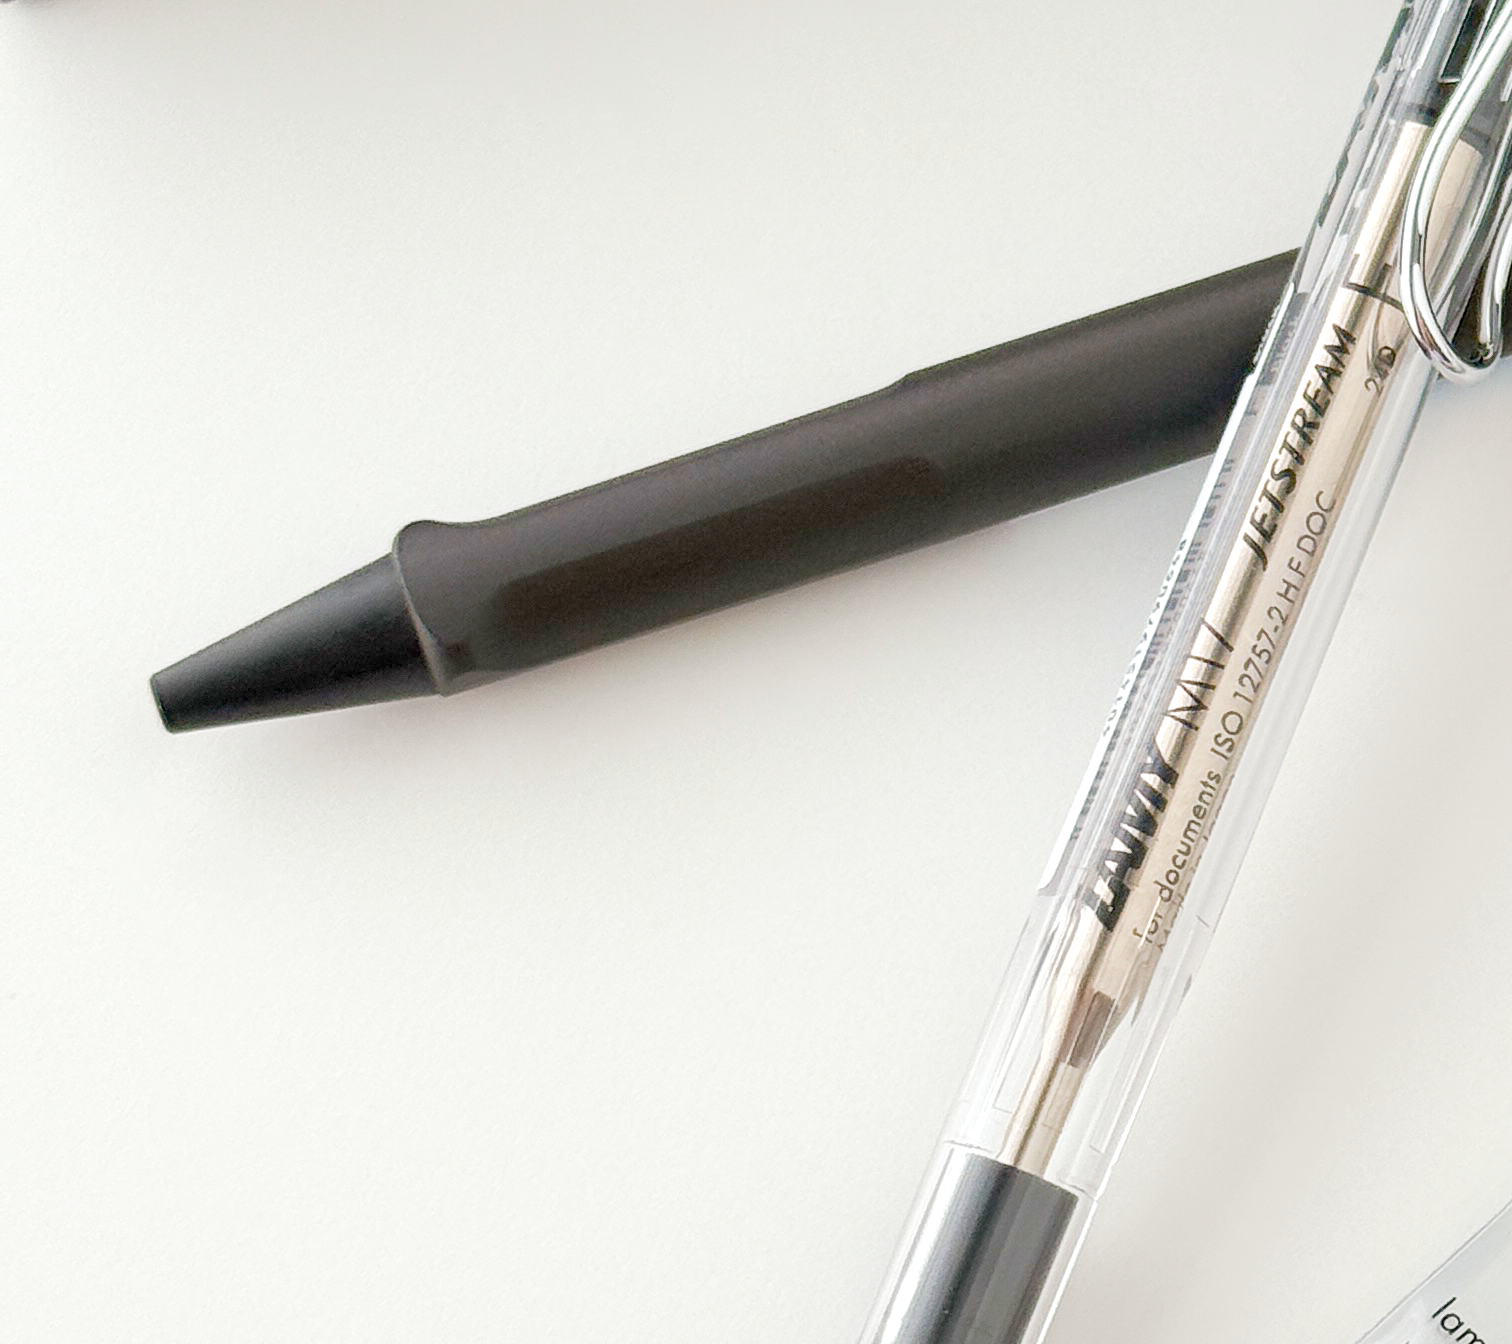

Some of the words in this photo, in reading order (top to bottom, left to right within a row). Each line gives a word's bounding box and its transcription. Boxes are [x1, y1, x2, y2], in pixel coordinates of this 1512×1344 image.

[1297, 490, 1337, 558] DOC
[1276, 577, 1301, 606] H
[1289, 556, 1307, 579] F
[1083, 746, 1180, 932] LAMY
[1161, 617, 1235, 732] M17
[1242, 323, 1357, 572] JETSTREAM
[1233, 606, 1289, 704] 12757-2
[1208, 710, 1244, 760] ISO
[1154, 769, 1223, 903] documents
